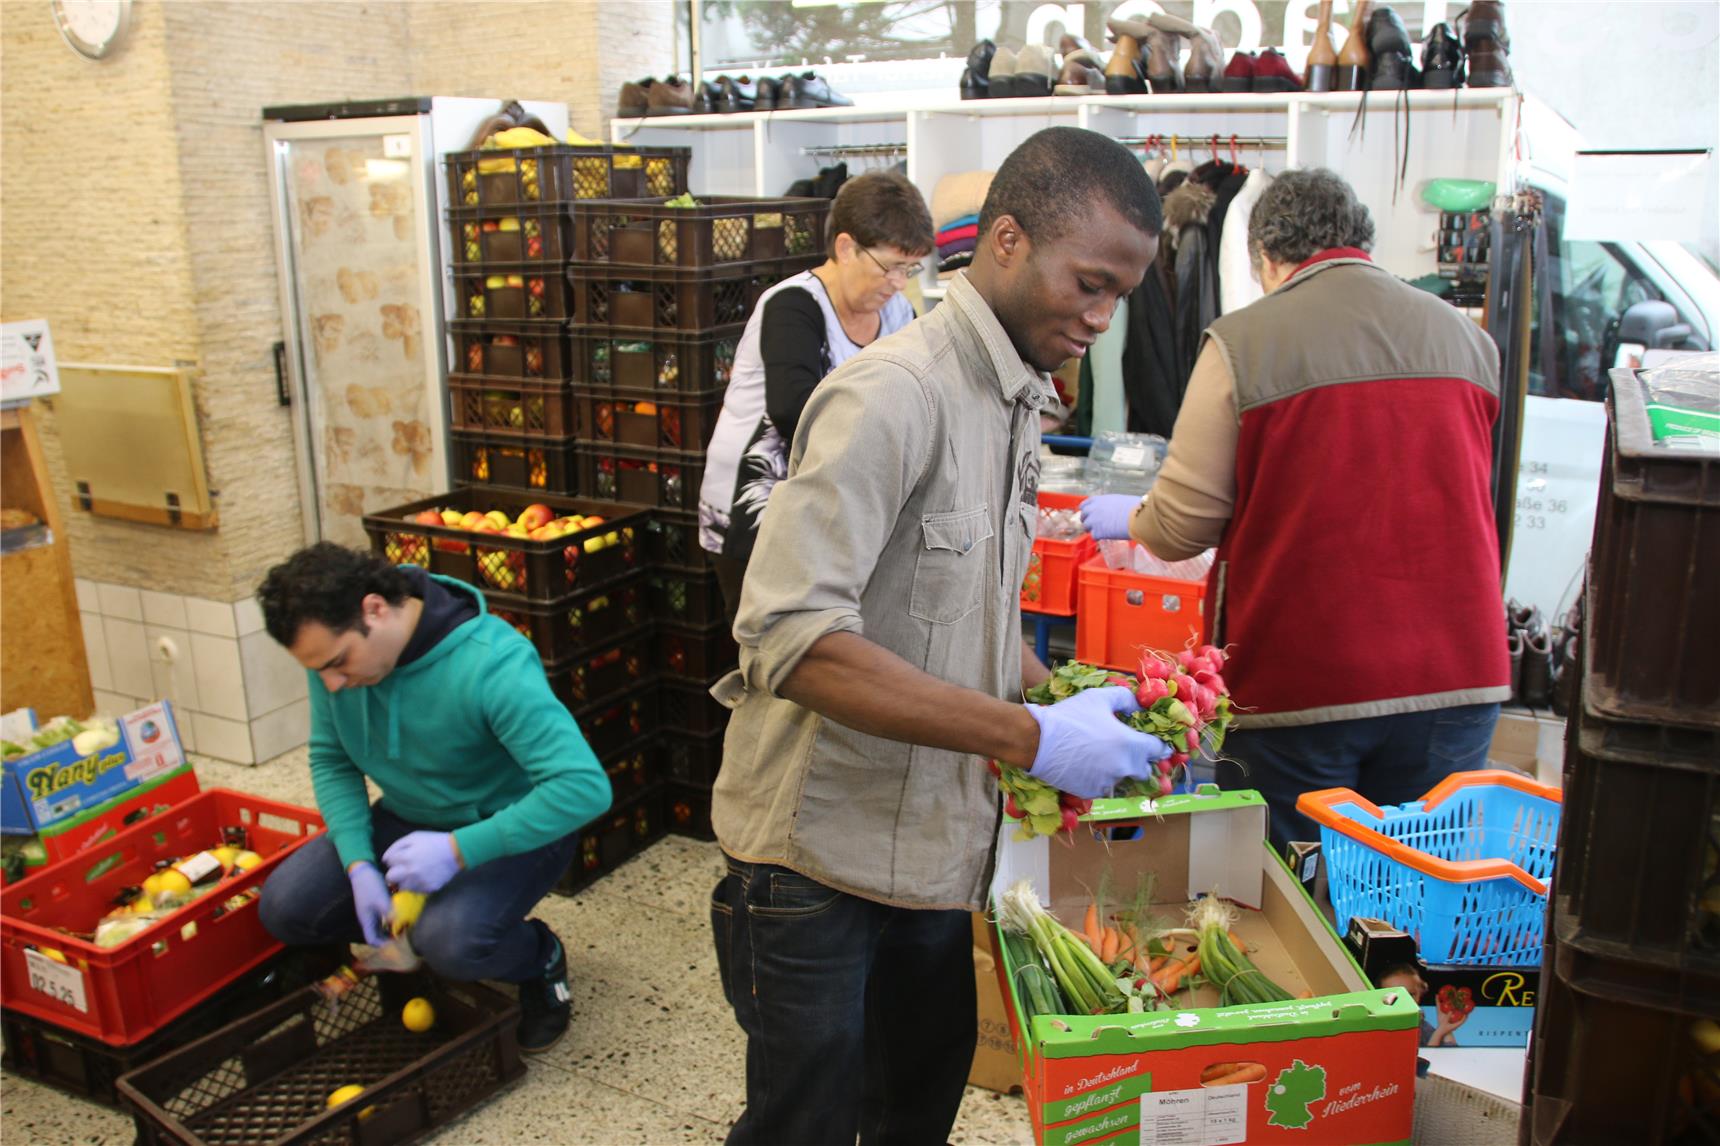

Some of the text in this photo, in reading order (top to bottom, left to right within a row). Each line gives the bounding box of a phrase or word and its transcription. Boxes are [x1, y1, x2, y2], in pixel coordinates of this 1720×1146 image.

[1530, 462, 1548, 473] 34
[1548, 499, 1567, 513] 36
[1526, 515, 1545, 529] 33
[1064, 1059, 1139, 1095] in Deutschland
[1064, 1085, 1122, 1117] gepflanzt
[1322, 1083, 1399, 1118] Niederrhein
[1064, 1115, 1128, 1144] gewachsen
